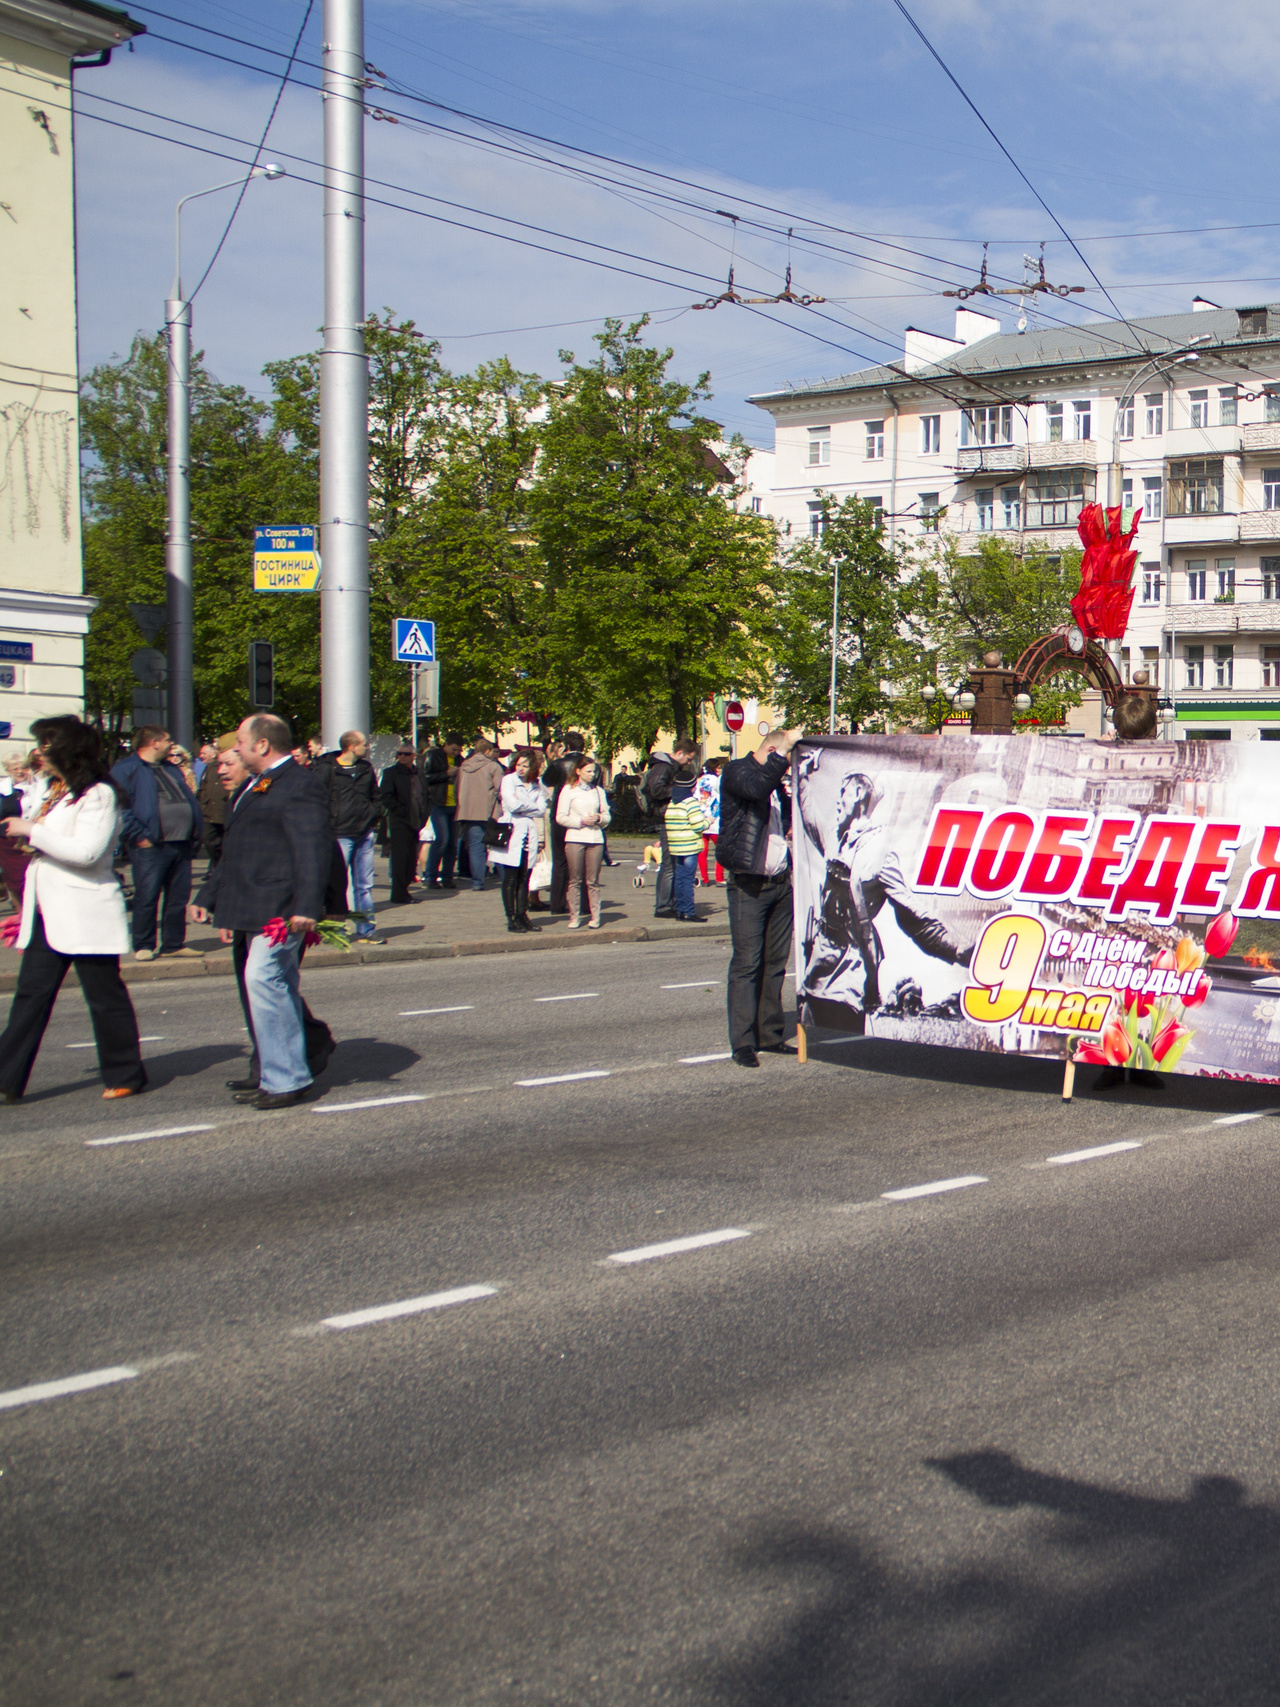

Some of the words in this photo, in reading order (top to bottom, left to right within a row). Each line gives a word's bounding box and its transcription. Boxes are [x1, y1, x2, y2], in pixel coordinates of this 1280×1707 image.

[271, 538, 286, 549] 100
[255, 560, 314, 571] ГОСТИНИЦА
[914, 806, 1242, 921] ПОБЕДЕ
[1069, 931, 1148, 964] Днём
[963, 914, 1046, 1022] 9
[1083, 959, 1206, 997] Победы!
[1018, 988, 1112, 1031] мая
[1233, 1049, 1250, 1060] 1941
